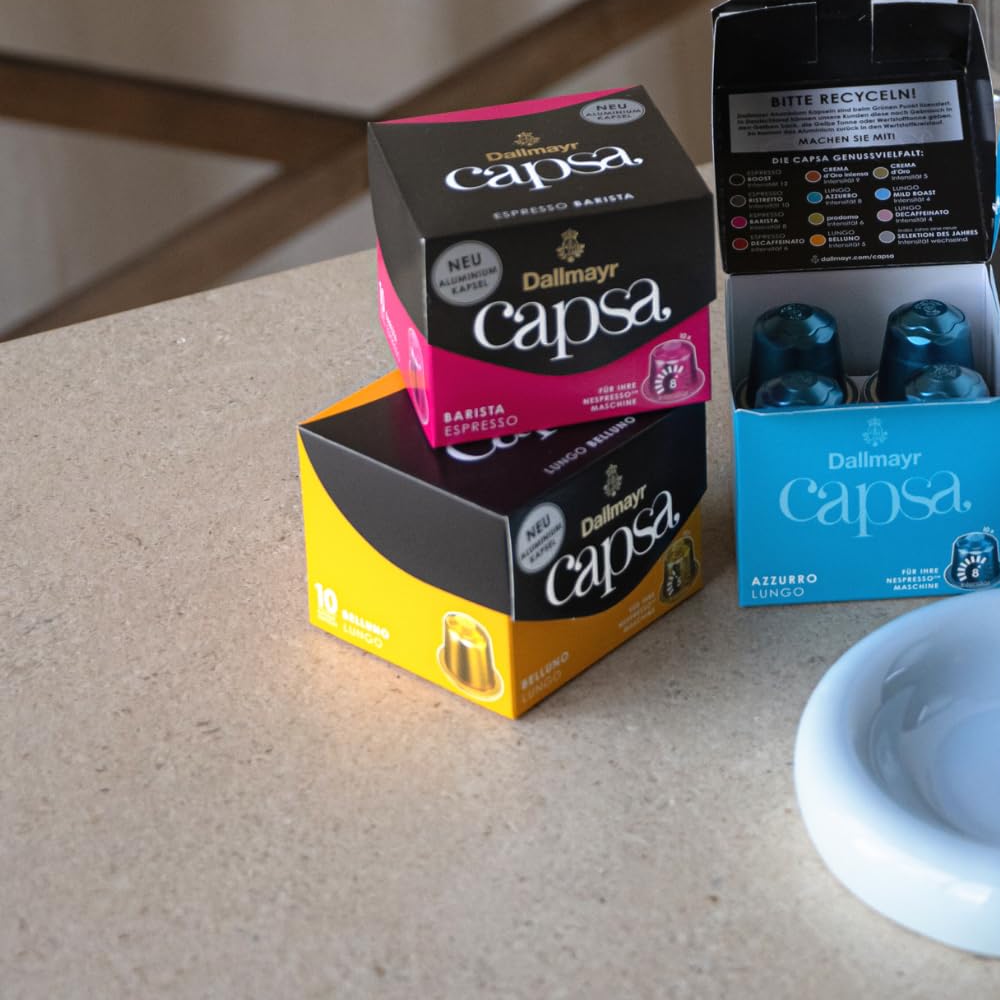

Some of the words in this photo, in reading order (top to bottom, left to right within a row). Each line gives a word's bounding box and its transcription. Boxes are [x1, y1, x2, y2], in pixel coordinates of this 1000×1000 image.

[596, 103, 627, 111] NEU
[771, 94, 813, 108] BITTE
[820, 88, 916, 105] RECYCELN!
[799, 136, 849, 145] MACHEN
[853, 134, 870, 142] SIE
[485, 140, 578, 163] Dallmayr
[772, 157, 790, 165] DIE
[793, 155, 830, 164] CAPSA
[832, 150, 924, 162] GENUSSVIELFALT:
[445, 146, 644, 192] capsa
[493, 202, 568, 219] ESPRESSO
[573, 192, 635, 208] BARISTA
[895, 209, 950, 217] DECAFFEINATO
[751, 238, 805, 246] DECAFFEINATO
[448, 251, 482, 272] NEU
[820, 253, 895, 262] dallmayr.com/capsa
[439, 265, 498, 288] ALUMINIUM
[522, 261, 619, 292] Dallmayr
[452, 279, 488, 295] KAPSEL
[473, 278, 672, 363] capsa
[597, 383, 615, 394] FÜR
[617, 381, 637, 391] IHRE
[669, 379, 677, 390] 8
[443, 404, 505, 423] BARISTA
[590, 398, 637, 412] MASCHINE
[444, 415, 518, 437] ESPRESSO
[544, 447, 588, 475] LUNGO
[585, 416, 636, 448] BELLUNO
[828, 452, 922, 470] Dallmayr
[581, 484, 647, 539] Dallmayr
[779, 471, 972, 538] capsa
[526, 513, 551, 542] NEU
[545, 490, 680, 606] capsa
[752, 573, 817, 586] AZZURRO
[902, 567, 917, 575] FÜR
[971, 568, 979, 578] 8
[752, 587, 805, 599] LUNGO
[893, 583, 939, 591] MASCHINE
[314, 582, 338, 614] 10
[341, 609, 390, 640] BELLUNO
[343, 623, 383, 649] LUNGO
